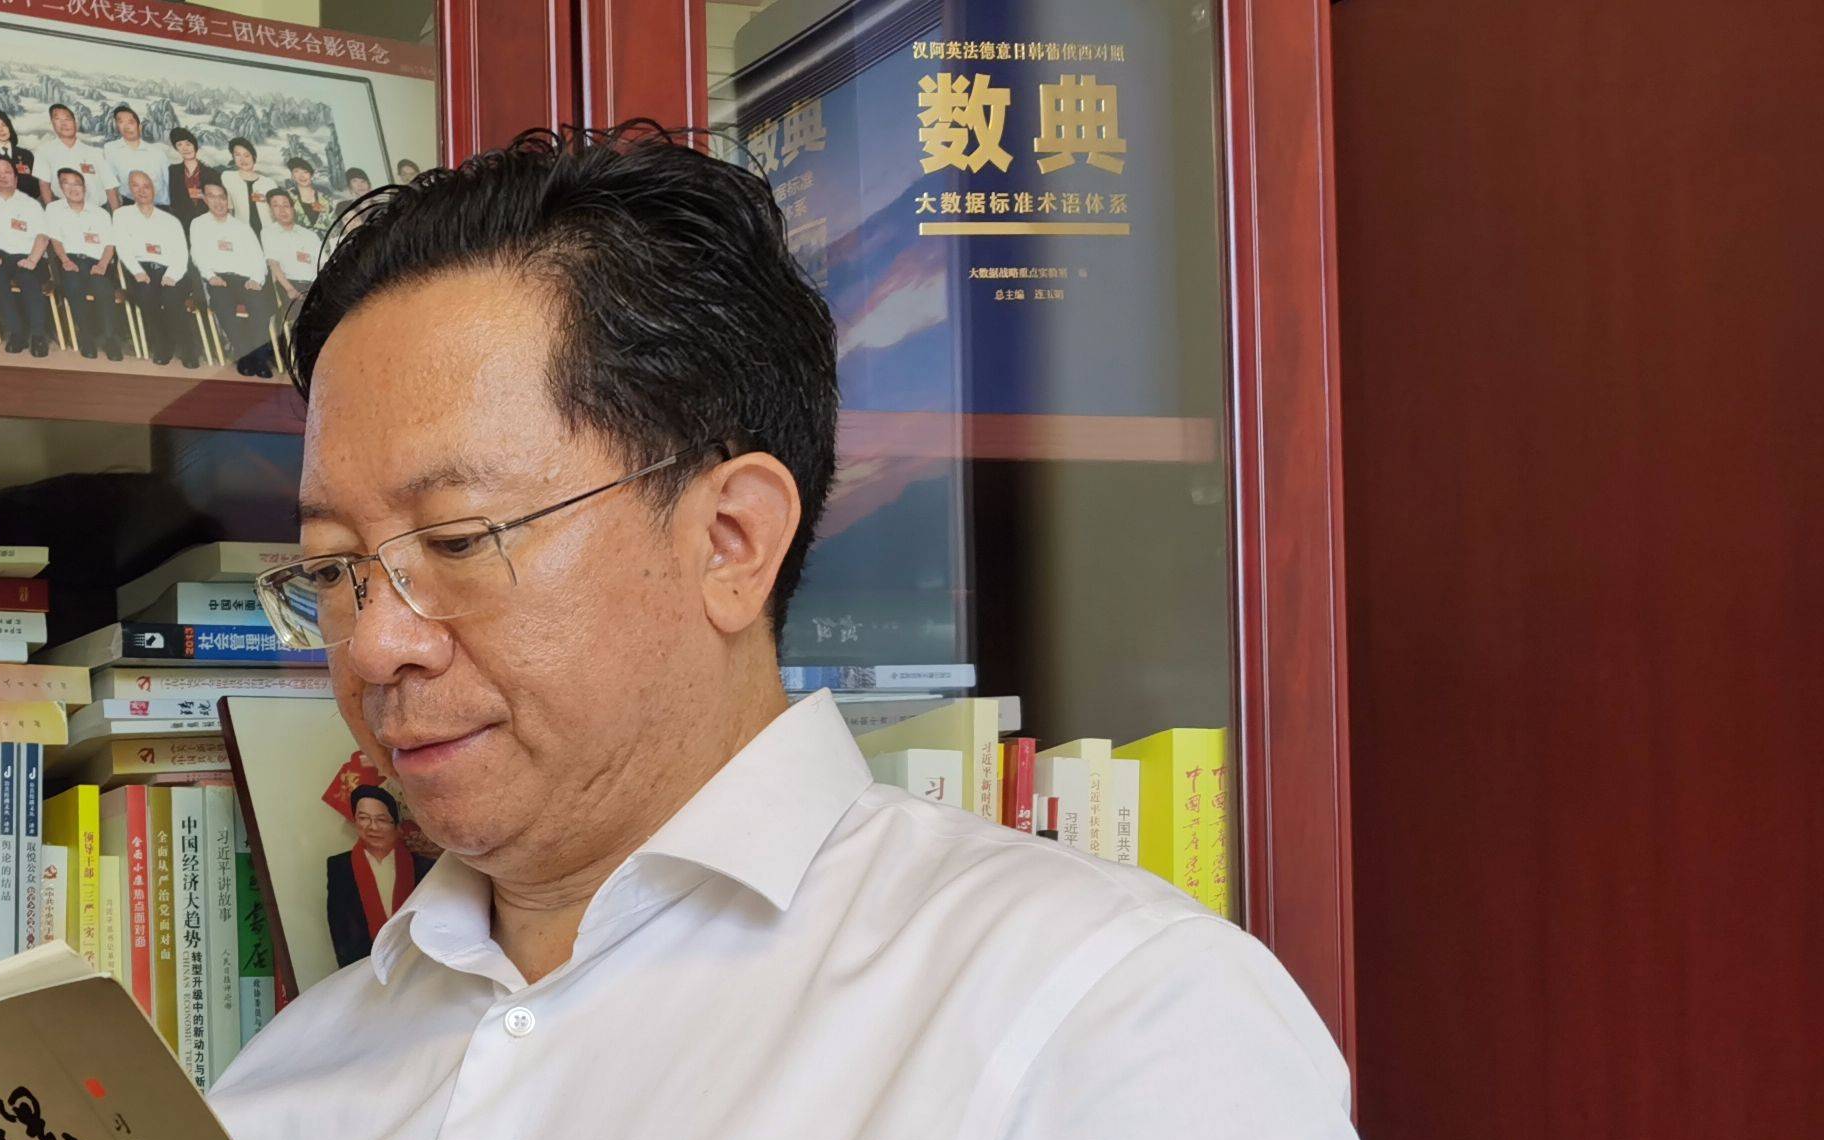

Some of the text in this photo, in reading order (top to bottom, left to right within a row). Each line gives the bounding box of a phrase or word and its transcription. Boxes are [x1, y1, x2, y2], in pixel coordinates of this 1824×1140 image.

[917, 72, 1128, 175] 数典
[915, 191, 1129, 216] 大数据标准术语体系
[925, 776, 945, 801] 习
[181, 815, 201, 949] 中国经济大趋势
